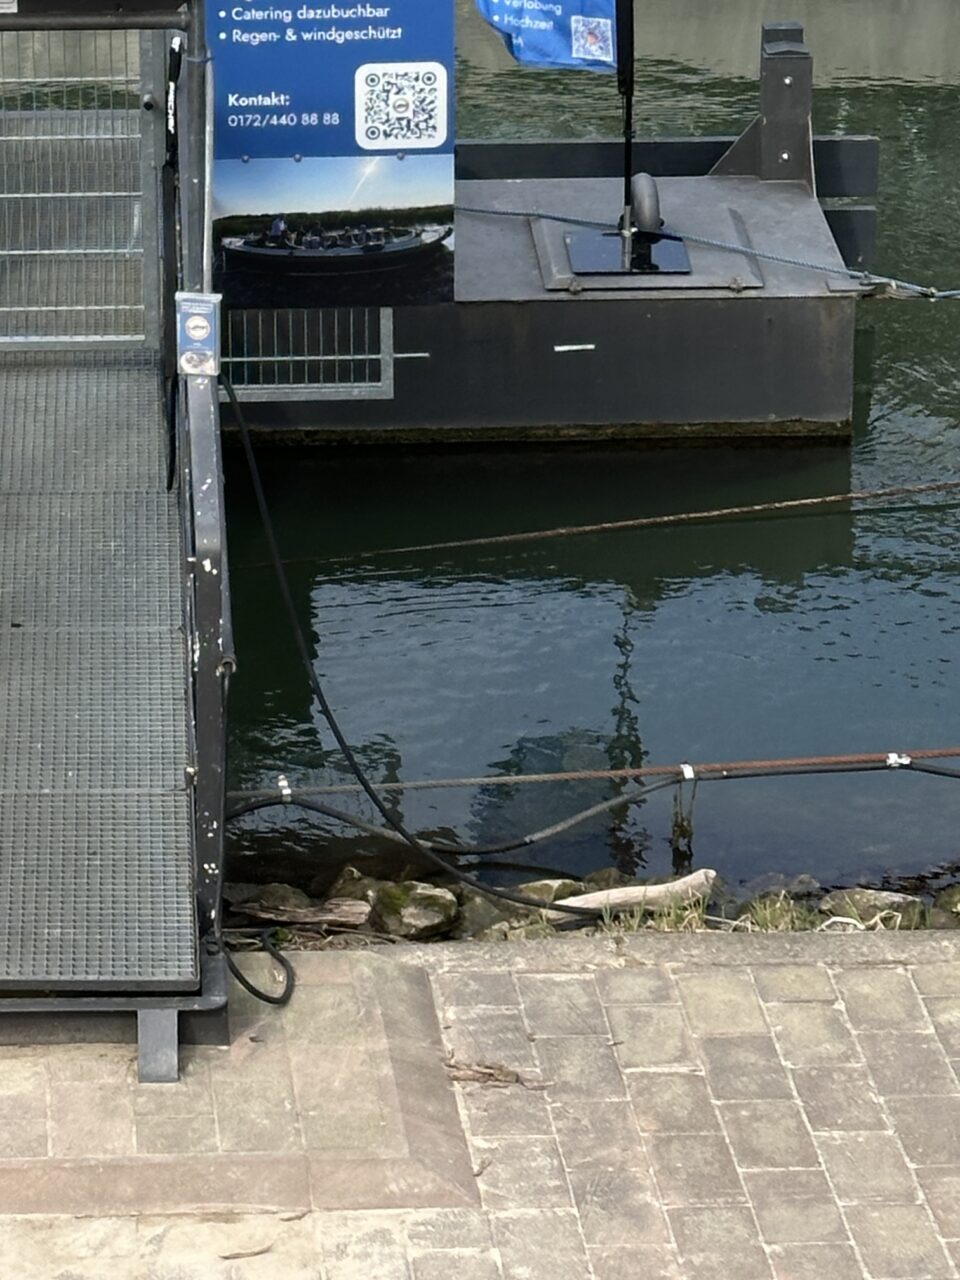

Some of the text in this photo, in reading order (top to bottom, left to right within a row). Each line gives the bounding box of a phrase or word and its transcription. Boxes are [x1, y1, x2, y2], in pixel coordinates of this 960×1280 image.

[232, 4, 390, 23] Catering dazubuchbar
[504, 14, 553, 29] Hochzeit
[233, 26, 402, 46] Regen- & windgeschützt
[228, 91, 290, 107] Kontakt:
[228, 113, 340, 127] 0172/440 88 88
